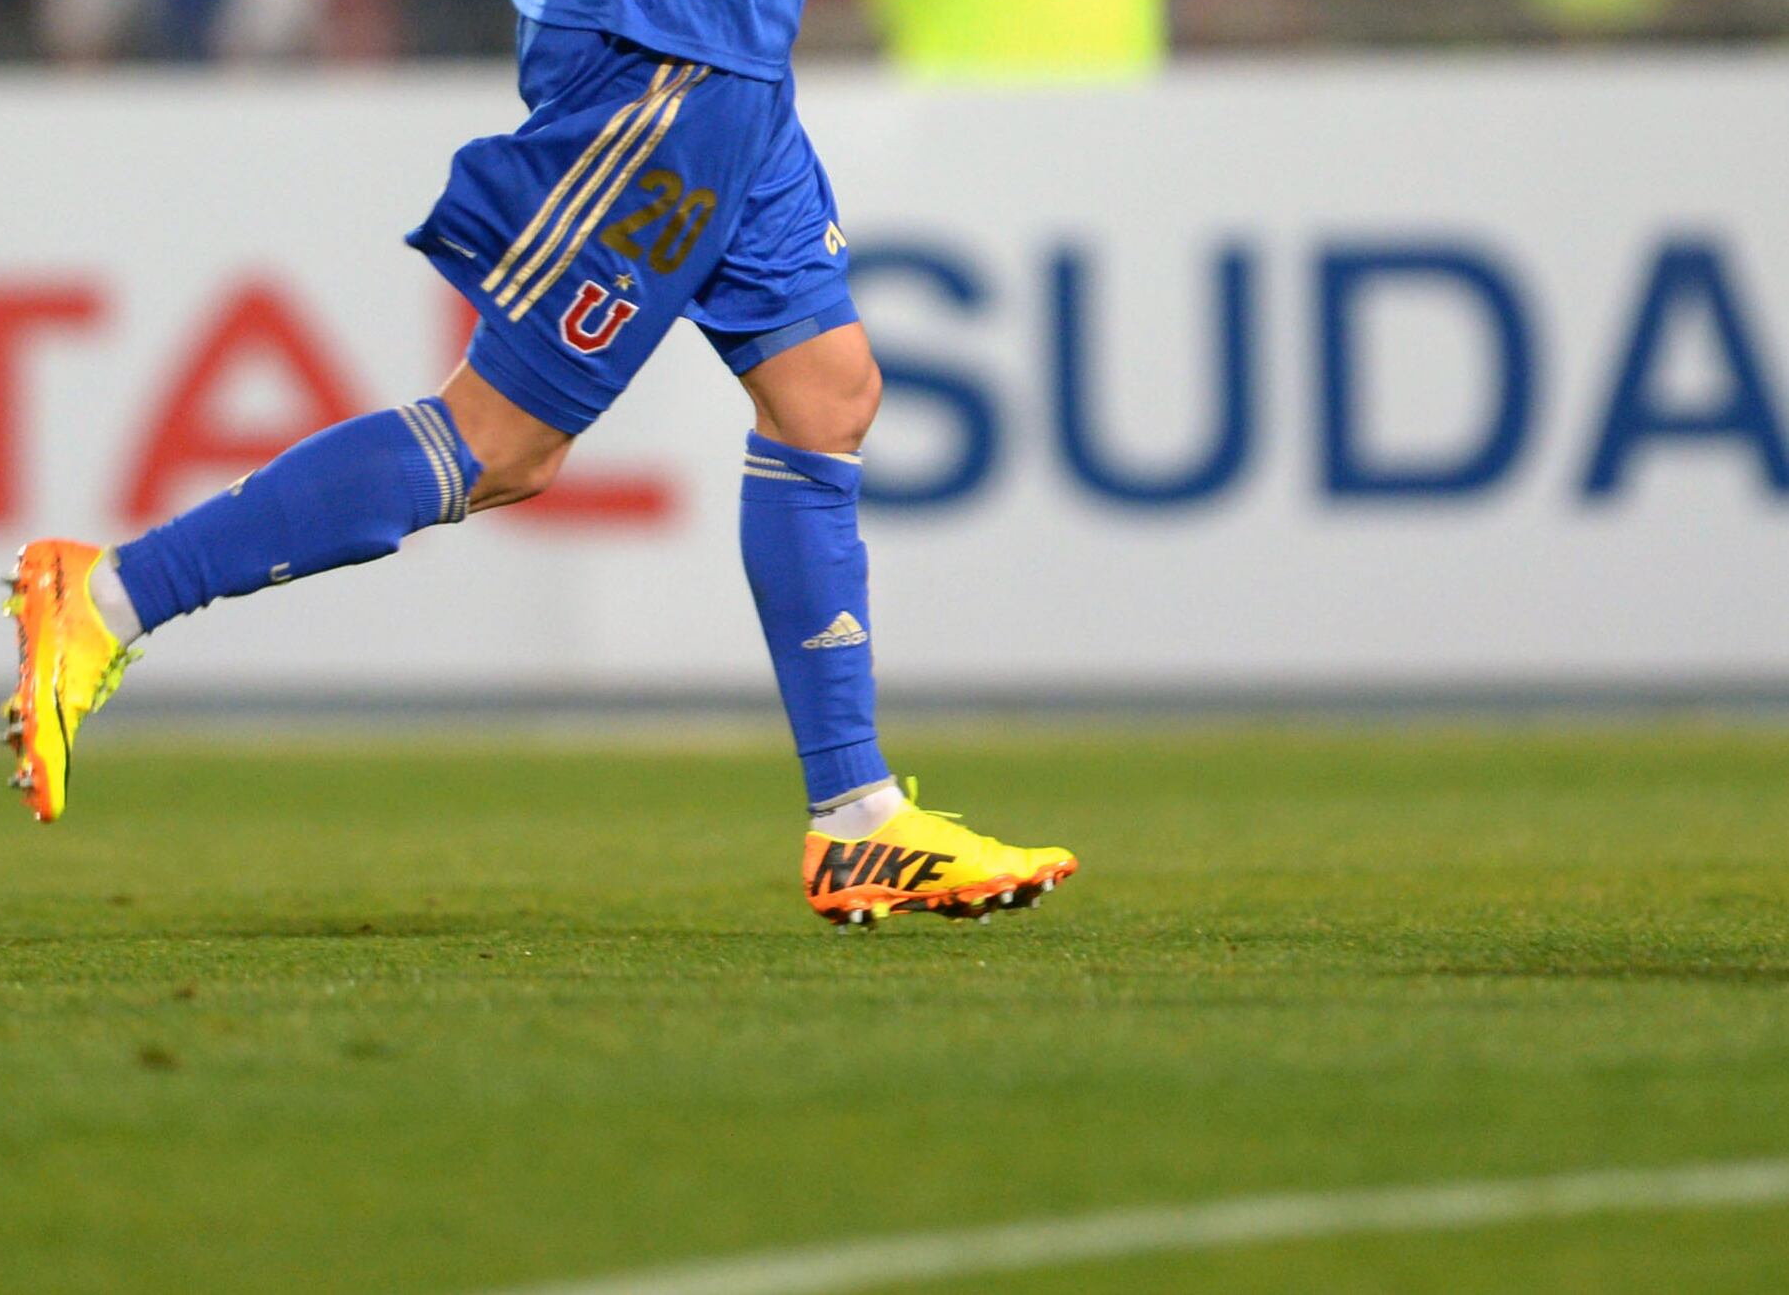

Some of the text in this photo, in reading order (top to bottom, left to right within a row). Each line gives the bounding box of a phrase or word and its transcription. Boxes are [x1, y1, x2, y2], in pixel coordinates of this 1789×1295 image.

[602, 170, 716, 273] 20
[559, 280, 639, 353] U
[845, 231, 1788, 512] SUDA
[812, 840, 956, 896] NIKE
